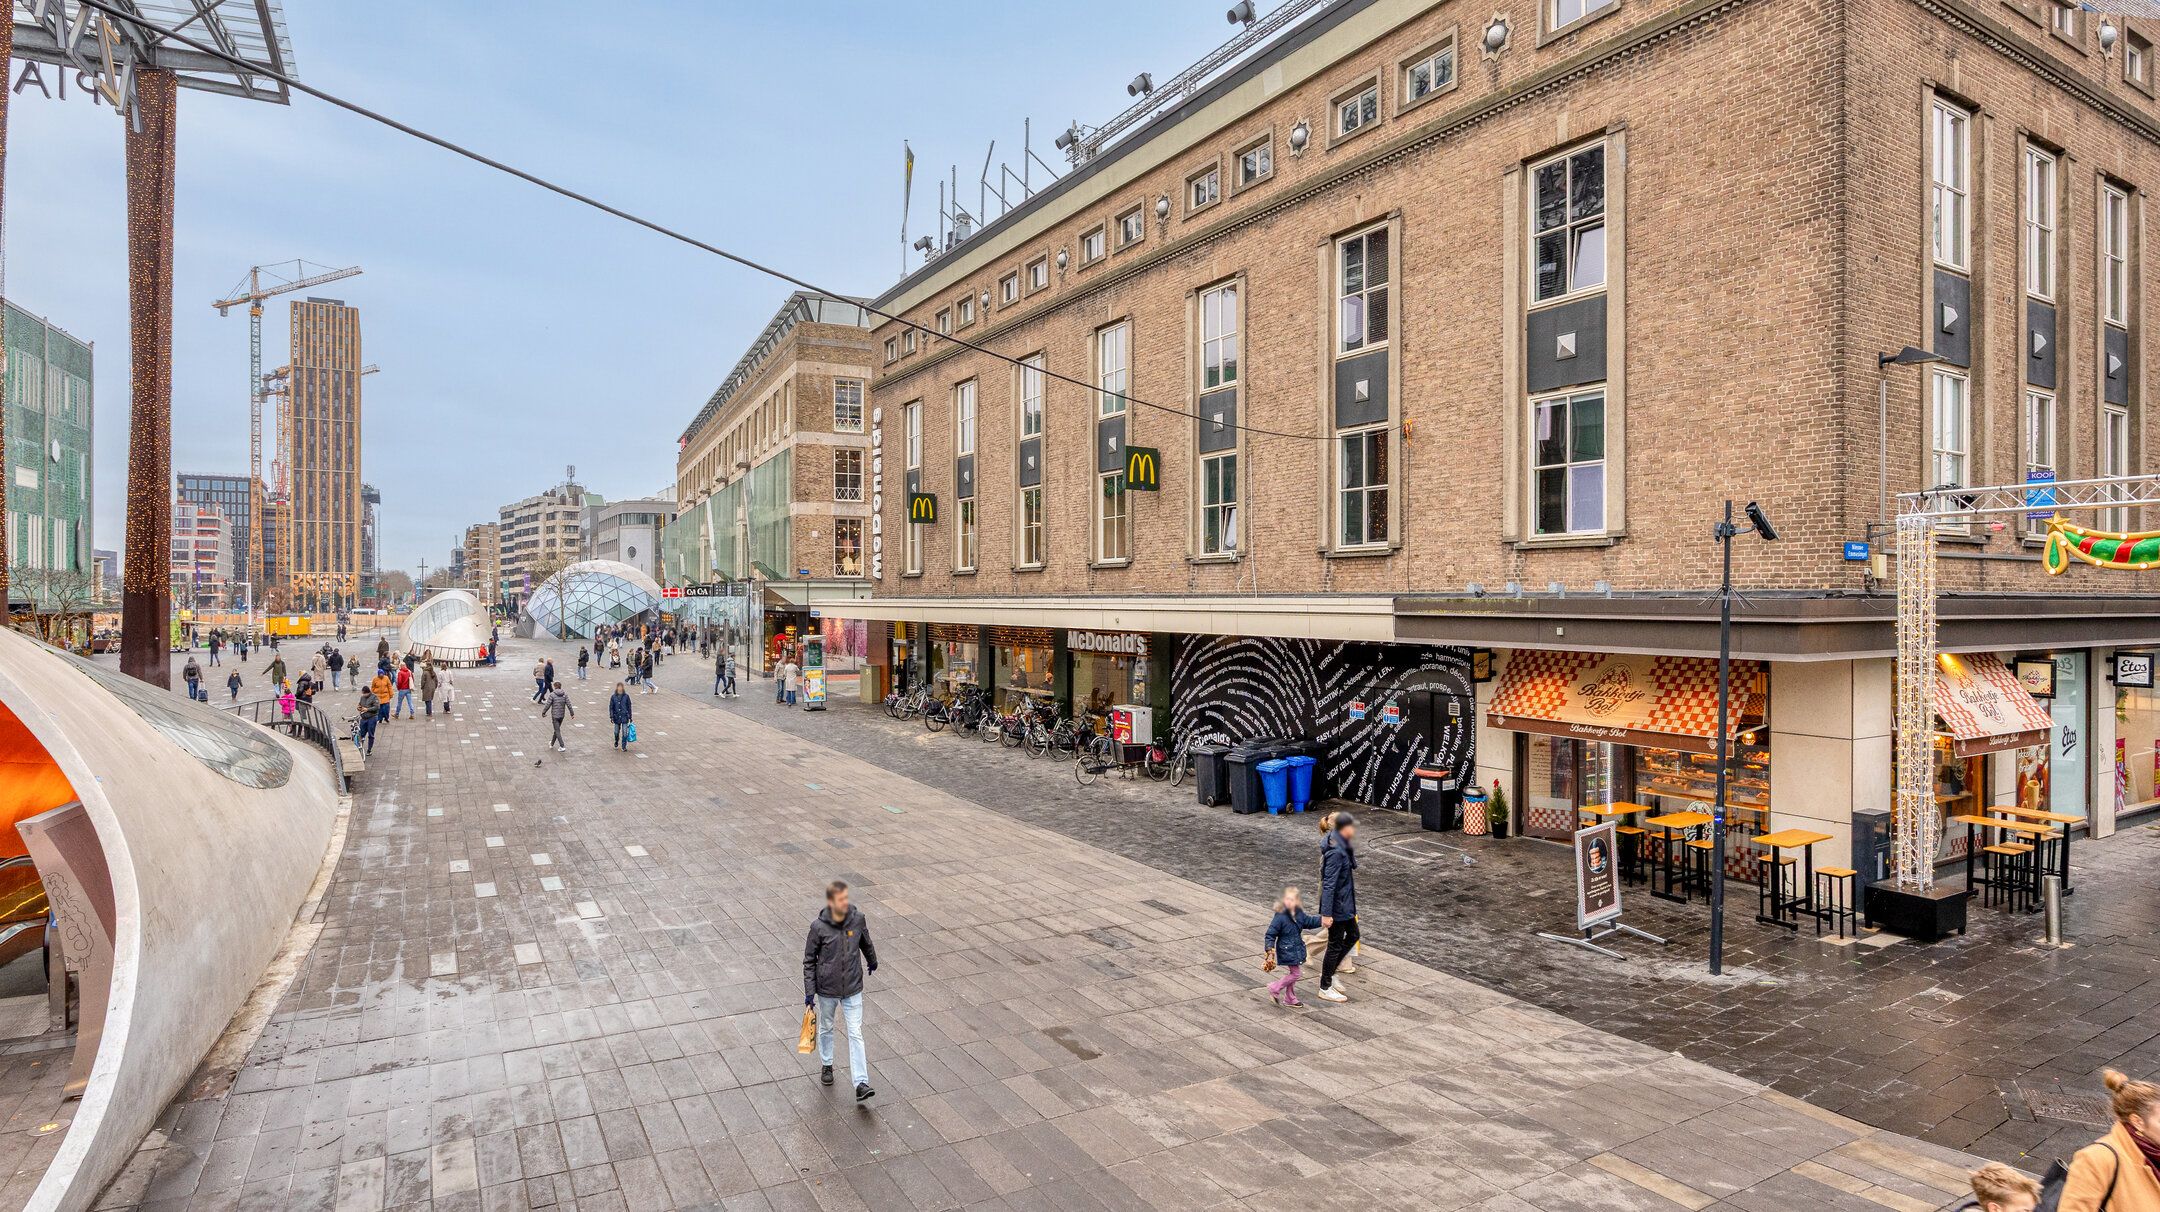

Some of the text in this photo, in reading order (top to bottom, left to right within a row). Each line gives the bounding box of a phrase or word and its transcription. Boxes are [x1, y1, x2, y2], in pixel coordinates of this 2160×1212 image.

[2031, 471, 2054, 479] KOOP
[872, 407, 882, 580] McDonald's
[1067, 631, 1148, 654] McDonald's
[1318, 653, 1335, 671] VERS,
[2120, 659, 2148, 673] Etos
[1577, 683, 1646, 703] Bakkertje
[1959, 689, 1999, 704] Bakkertje
[1583, 697, 1619, 711] Bol
[1978, 701, 1998, 718] Bol
[1316, 730, 1332, 743] EASY,
[1569, 723, 1628, 738] Bakkertje Bol
[2062, 725, 2077, 748] Etos
